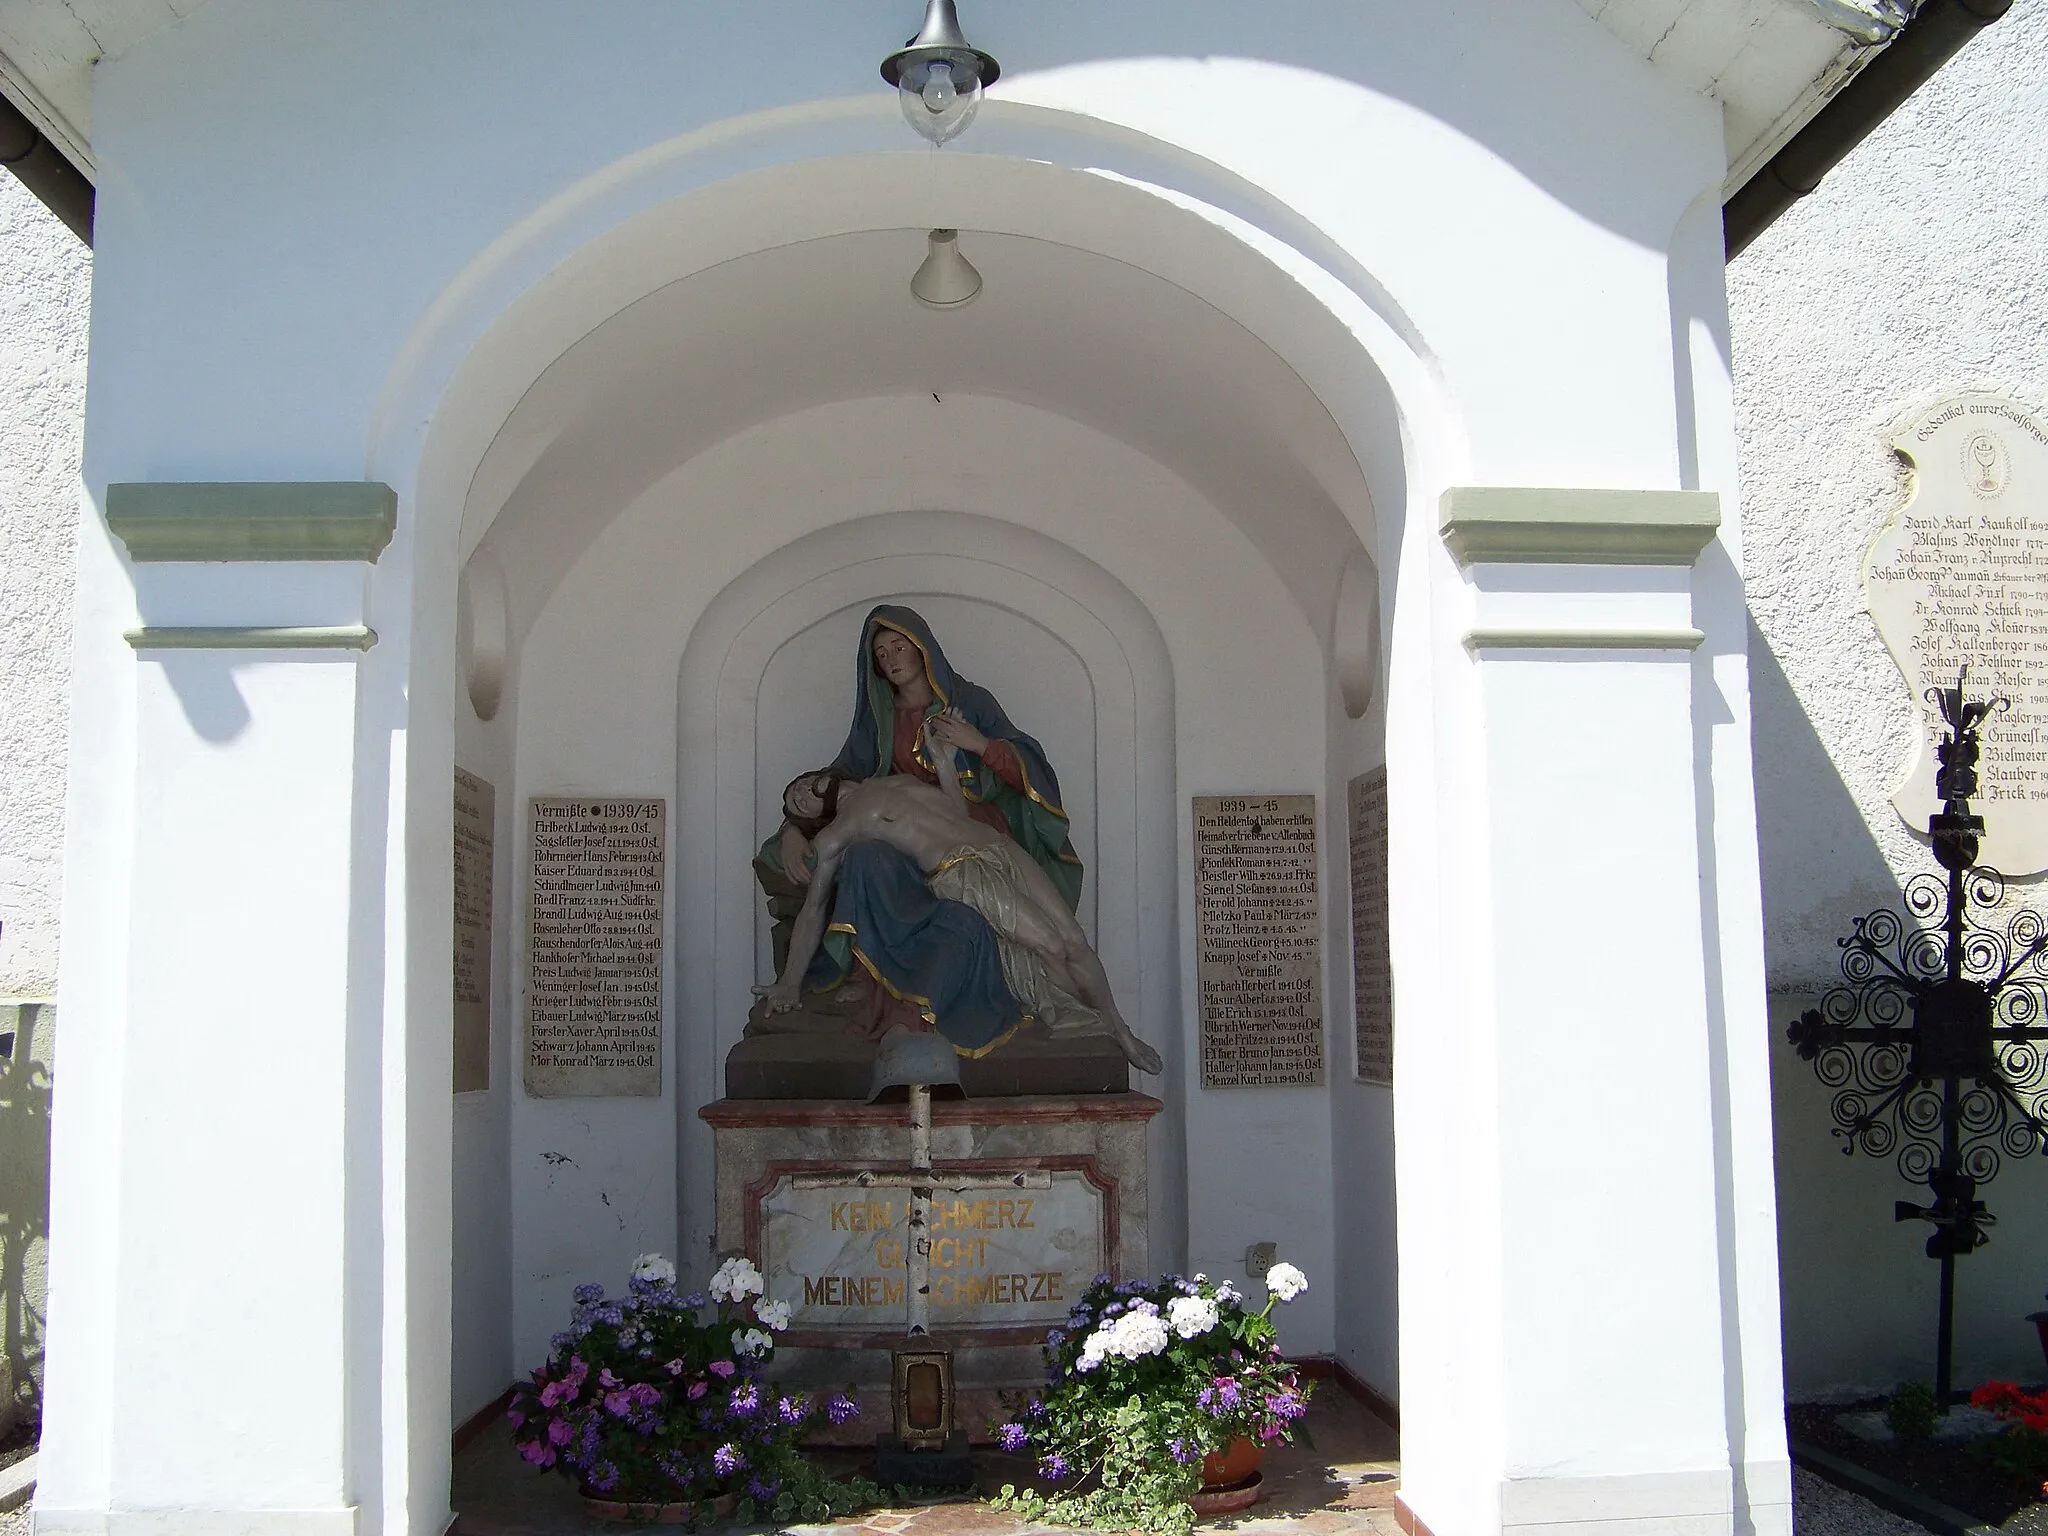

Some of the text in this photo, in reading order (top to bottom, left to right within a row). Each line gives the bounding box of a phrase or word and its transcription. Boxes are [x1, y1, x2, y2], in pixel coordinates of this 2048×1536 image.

[1904, 515, 1941, 529] David
[1942, 515, 1973, 529] Karl
[1933, 549, 1969, 567] Franz
[1928, 584, 1971, 599] Michael
[1931, 600, 2022, 616] Konrad Schick
[1923, 617, 1980, 637] Wolfgang
[1978, 652, 2022, 670] Fehlner
[1987, 764, 2036, 783] Stauber
[1989, 784, 2026, 803] Frick
[535, 803, 658, 818] Vermißte 1939/45
[1219, 800, 1246, 812] 1939
[1199, 814, 1313, 827] Den Heldentod haben erlitten
[575, 821, 606, 834] Ludwig
[584, 836, 607, 848] Josef
[535, 850, 583, 861] Rohrmeier
[584, 850, 608, 861] Hans
[1235, 856, 1266, 867] Roman
[535, 865, 566, 876] Kaiser
[567, 865, 602, 876] Eduard
[535, 879, 593, 891] Schindlmeier
[596, 880, 629, 893] Ludwig
[1235, 882, 1265, 895] Stefan
[534, 894, 558, 905] Riedl
[558, 894, 587, 905] Franz
[1203, 897, 1270, 909] Herold Johann
[534, 908, 566, 919] Brandl
[568, 908, 604, 922] Ludwig
[1244, 910, 1266, 920] Paul
[583, 923, 601, 934] Otto
[1232, 923, 1261, 934] Heinz
[604, 938, 625, 949] Alois
[1249, 937, 1280, 950] Georg
[581, 951, 615, 963] Michael
[1204, 951, 1235, 965] Knapp
[1236, 951, 1261, 963] Josef
[533, 966, 623, 979] Preis Ludwig Januar
[1237, 965, 1282, 978] Vermißte
[534, 980, 578, 992] Weninger
[579, 981, 602, 993] Josef
[1241, 980, 1276, 991] Herbert
[532, 995, 569, 1008] Krieger
[570, 995, 602, 1008] Ludwig
[1235, 992, 1266, 1004] Albert
[570, 1010, 603, 1023] Ludwig
[1226, 1006, 1252, 1018] Erich
[532, 1025, 567, 1036] Forster
[566, 1026, 597, 1036] Xaver
[597, 1026, 621, 1039] April
[1205, 1020, 1239, 1032] Ulbrich
[1239, 1020, 1273, 1032] Werner
[1205, 1034, 1235, 1046] Mende
[1235, 1033, 1257, 1045] Fritz
[532, 1040, 575, 1052] Schwarz
[575, 1041, 610, 1054] Johann
[611, 1041, 636, 1054] April
[1239, 1046, 1269, 1058] Bruno
[553, 1055, 589, 1066] Konrad
[1206, 1061, 1236, 1073] Haller
[1236, 1059, 1268, 1072] Johann
[1206, 1074, 1239, 1086] Menzel
[1240, 1072, 1263, 1085] Kurt
[831, 1198, 1035, 1232] KEIN CHMERZ
[874, 1234, 991, 1270] GLICHT
[804, 1275, 904, 1306] MEINEM
